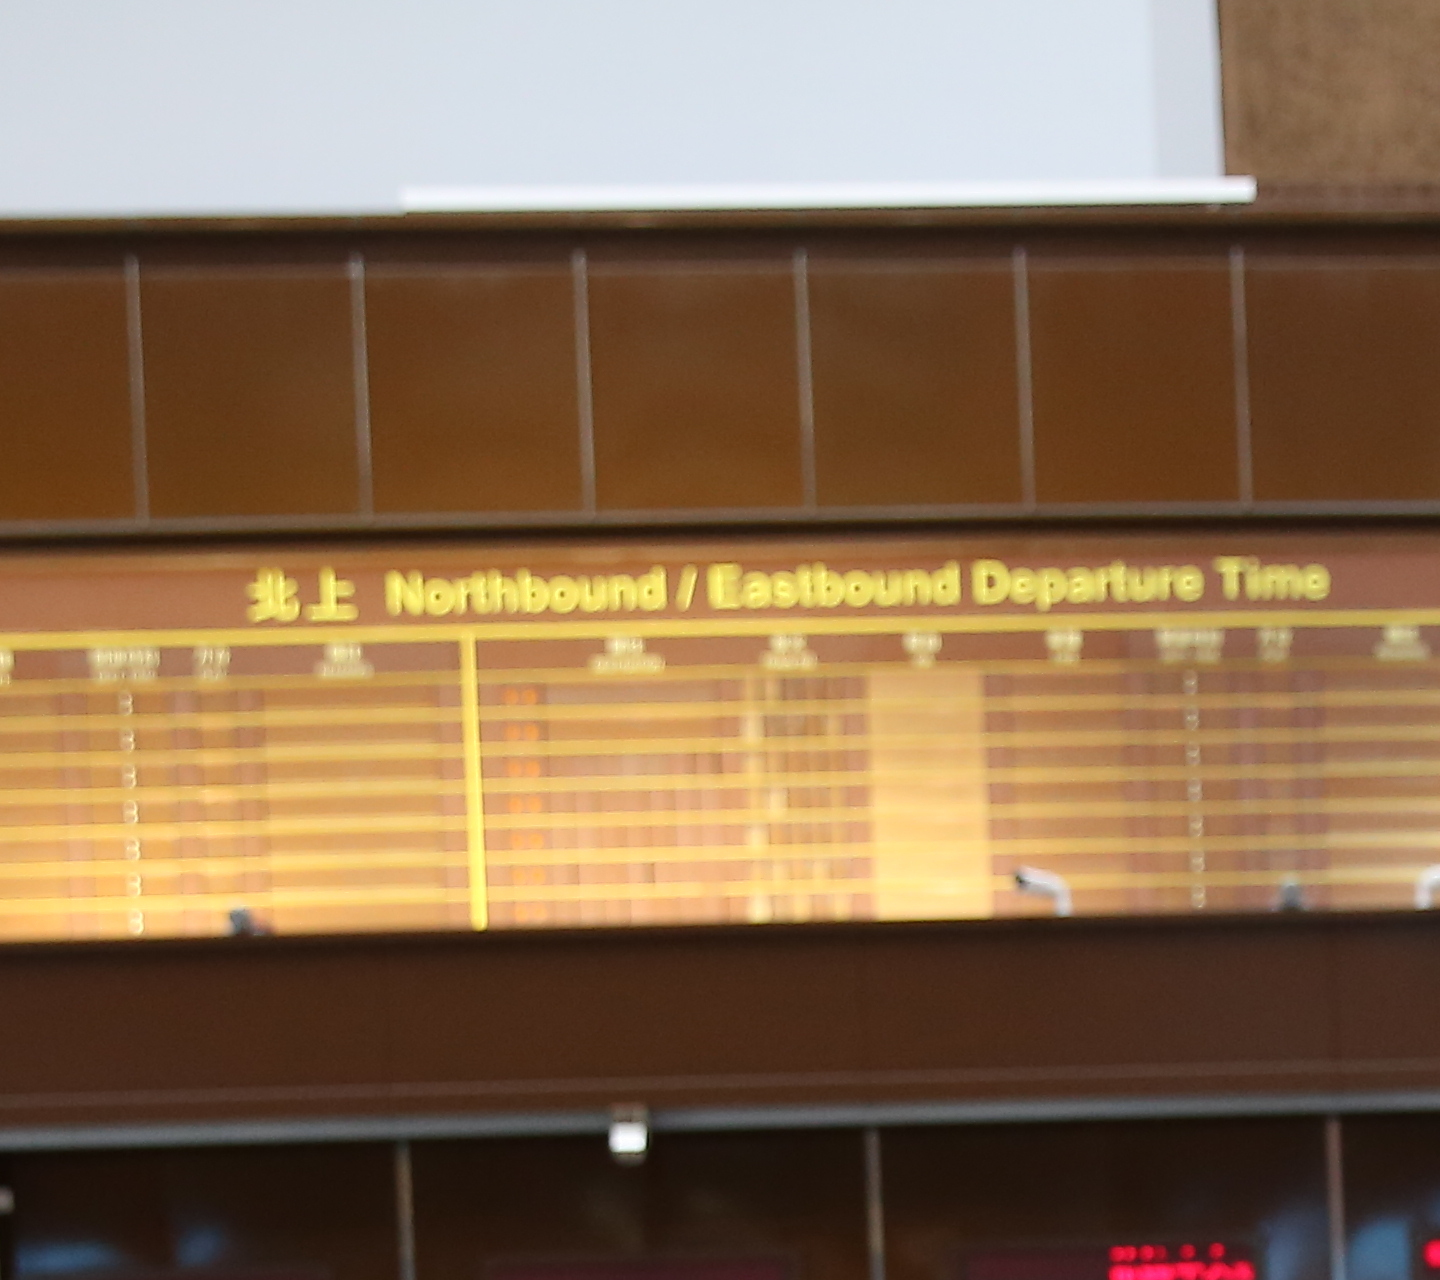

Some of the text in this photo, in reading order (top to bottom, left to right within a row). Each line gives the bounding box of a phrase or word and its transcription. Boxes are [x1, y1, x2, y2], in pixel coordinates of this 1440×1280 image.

[246, 555, 1332, 623] 北上 Northbound / Eastbound Departure Time
